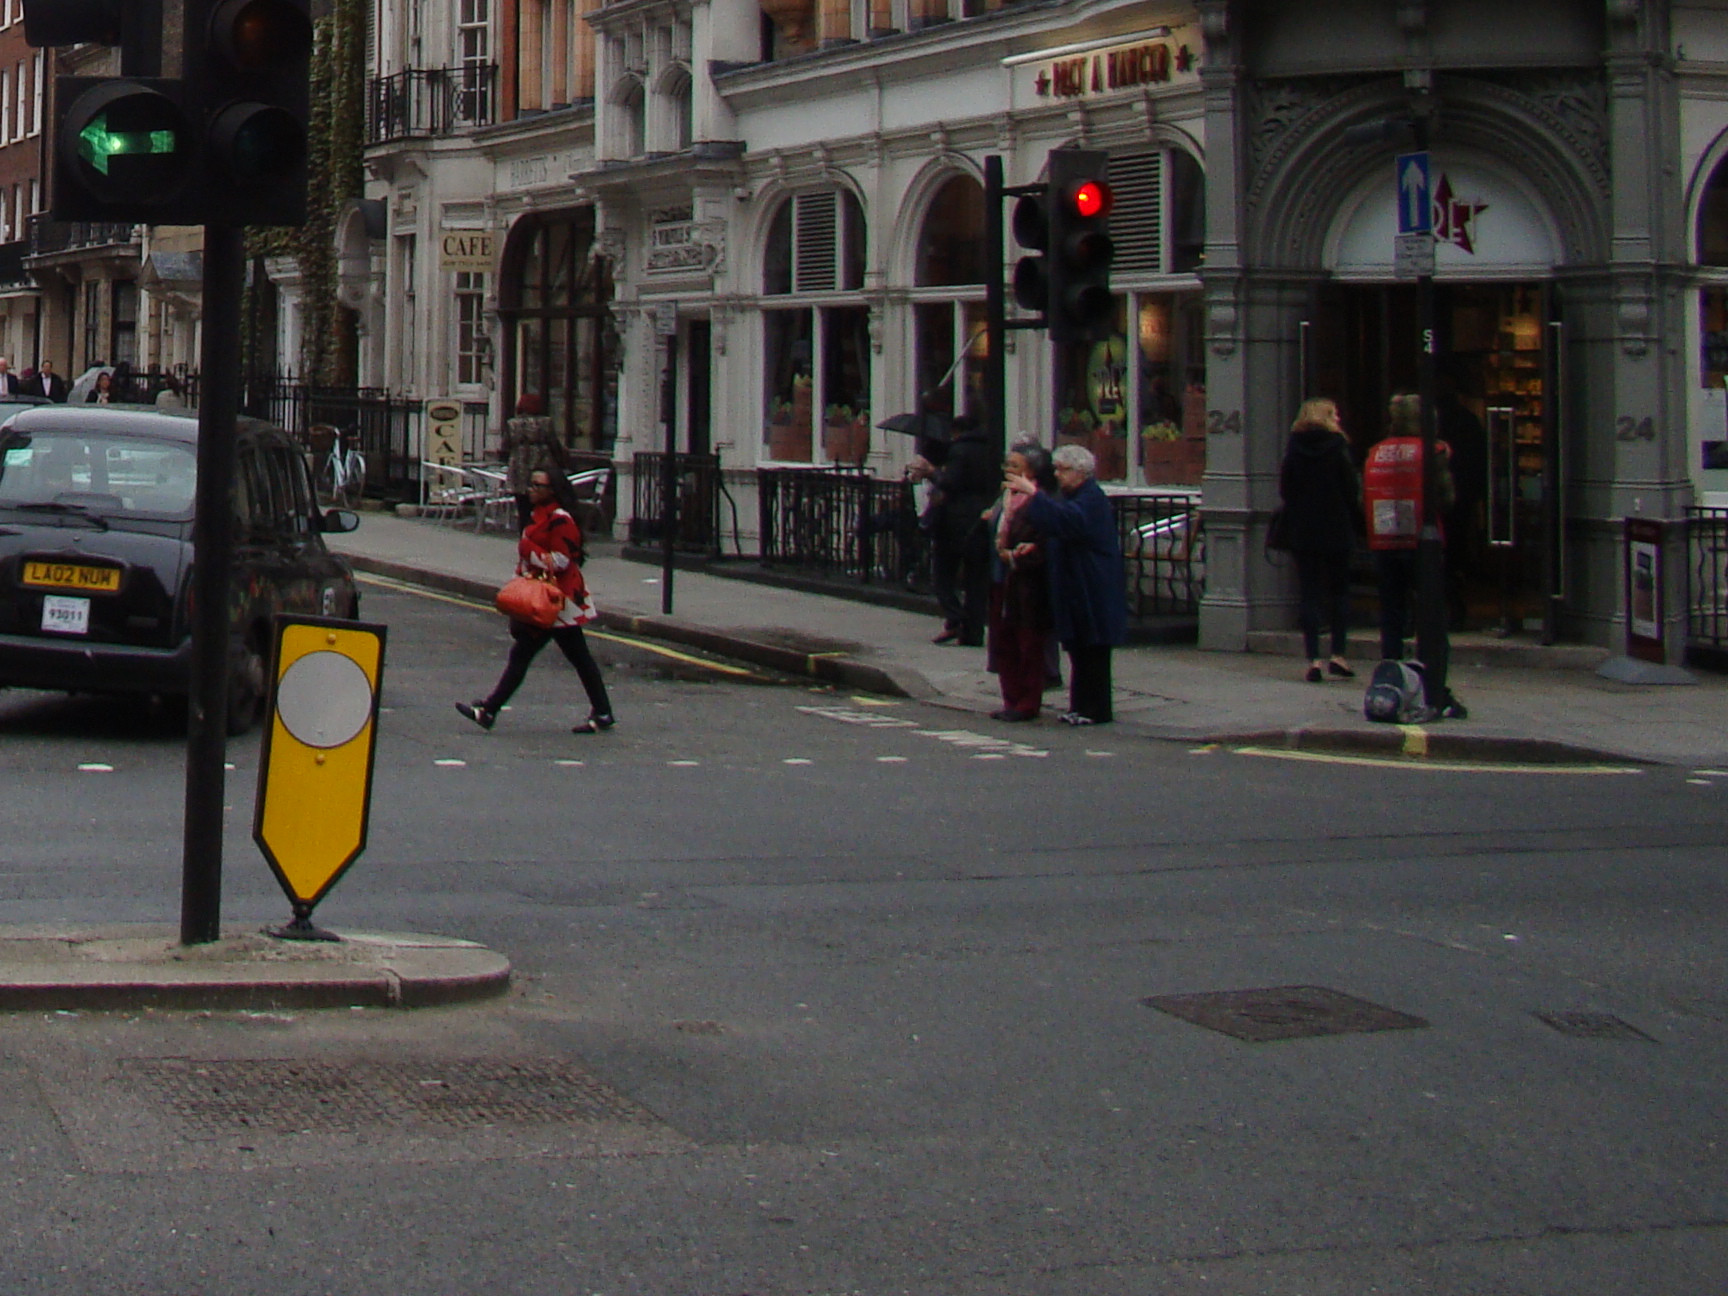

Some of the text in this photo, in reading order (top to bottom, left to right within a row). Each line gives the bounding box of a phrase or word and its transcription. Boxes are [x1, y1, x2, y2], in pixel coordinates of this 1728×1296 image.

[1091, 55, 1102, 93] A
[442, 235, 492, 257] CAFE
[1208, 409, 1241, 434] 24
[1617, 416, 1656, 442] 24
[31, 564, 74, 583] LA02
